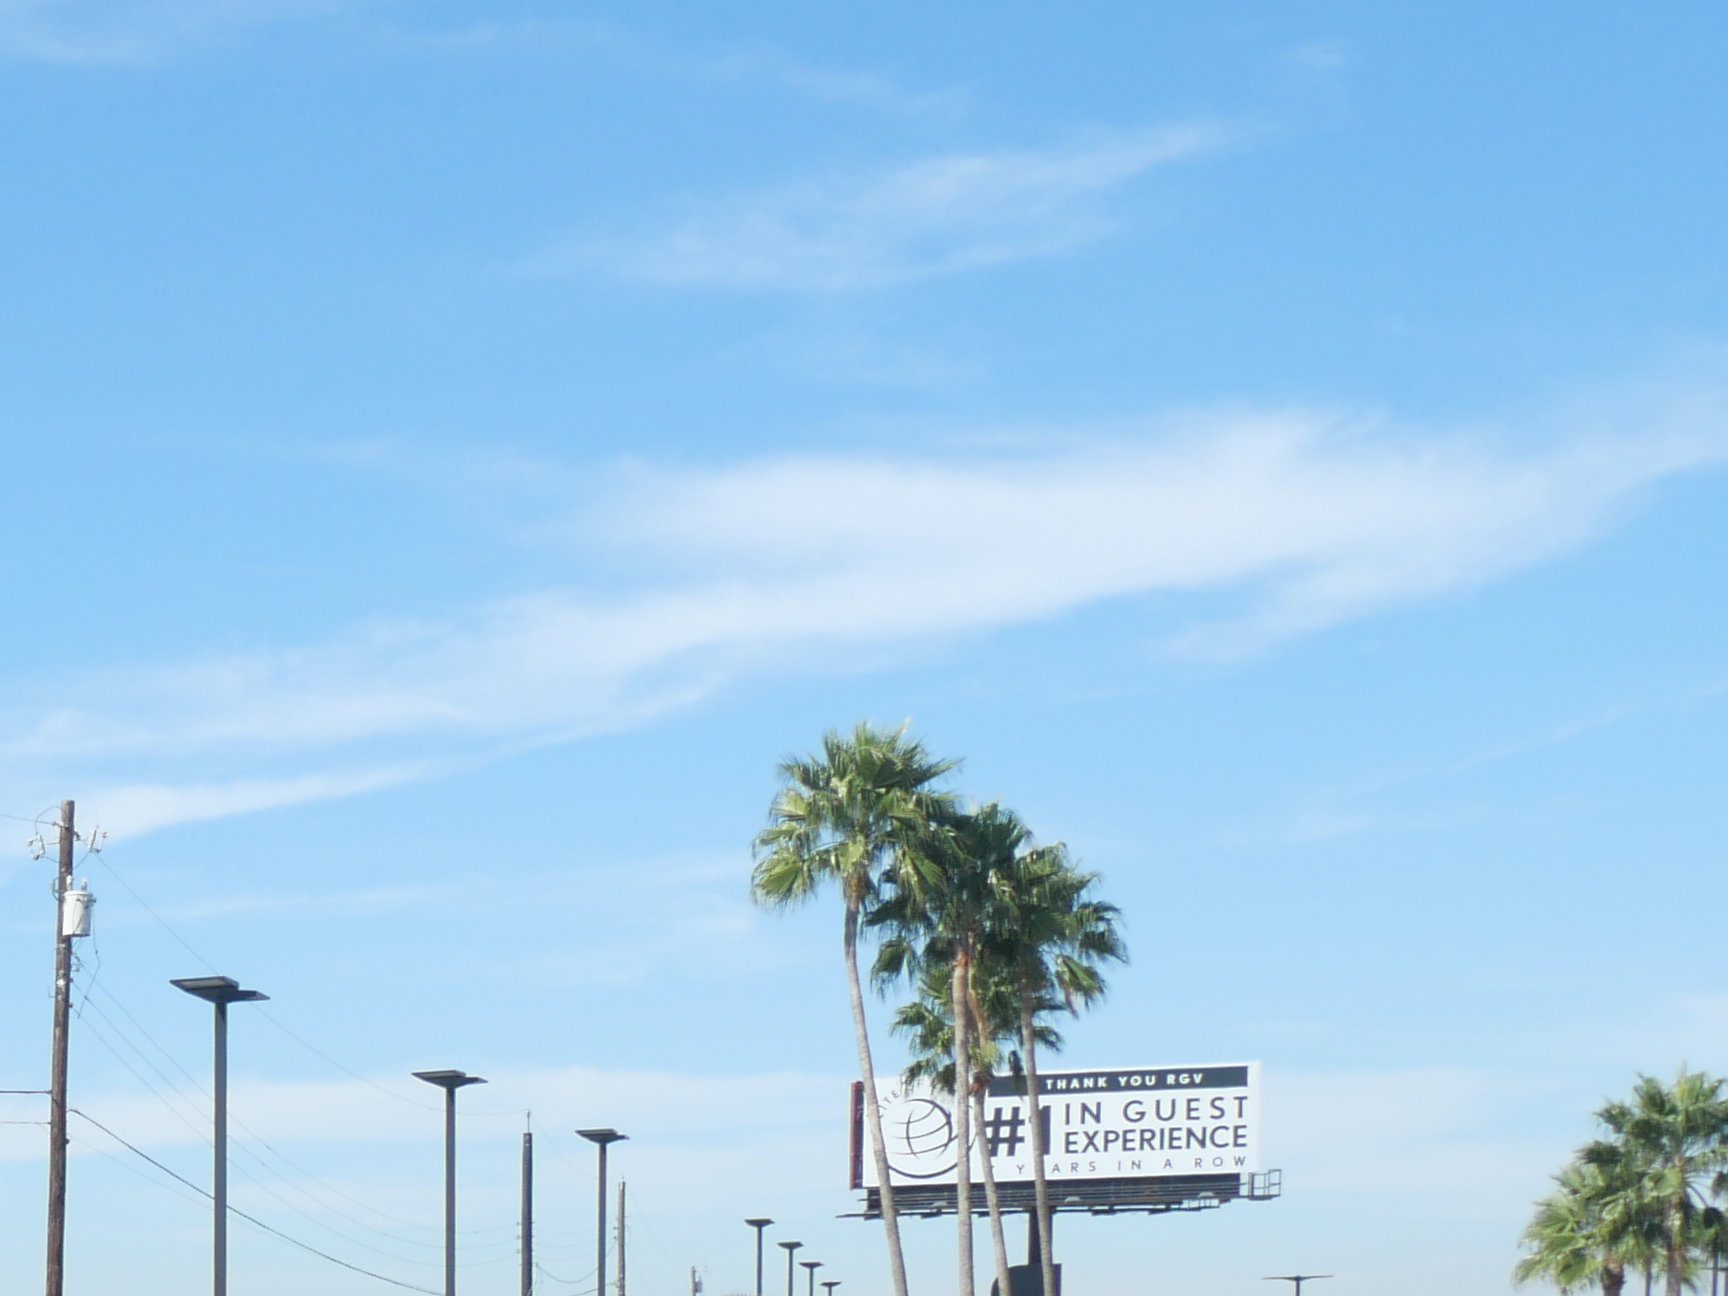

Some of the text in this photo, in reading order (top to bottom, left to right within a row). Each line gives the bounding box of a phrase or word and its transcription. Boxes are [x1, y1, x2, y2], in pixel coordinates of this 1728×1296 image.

[1046, 1073, 1204, 1090] THANK YOU RGV
[1065, 1096, 1248, 1125] IN GUEST
[1064, 1125, 1248, 1154] EXPERIENCE
[1016, 1156, 1247, 1174] YARS IN A ROW
